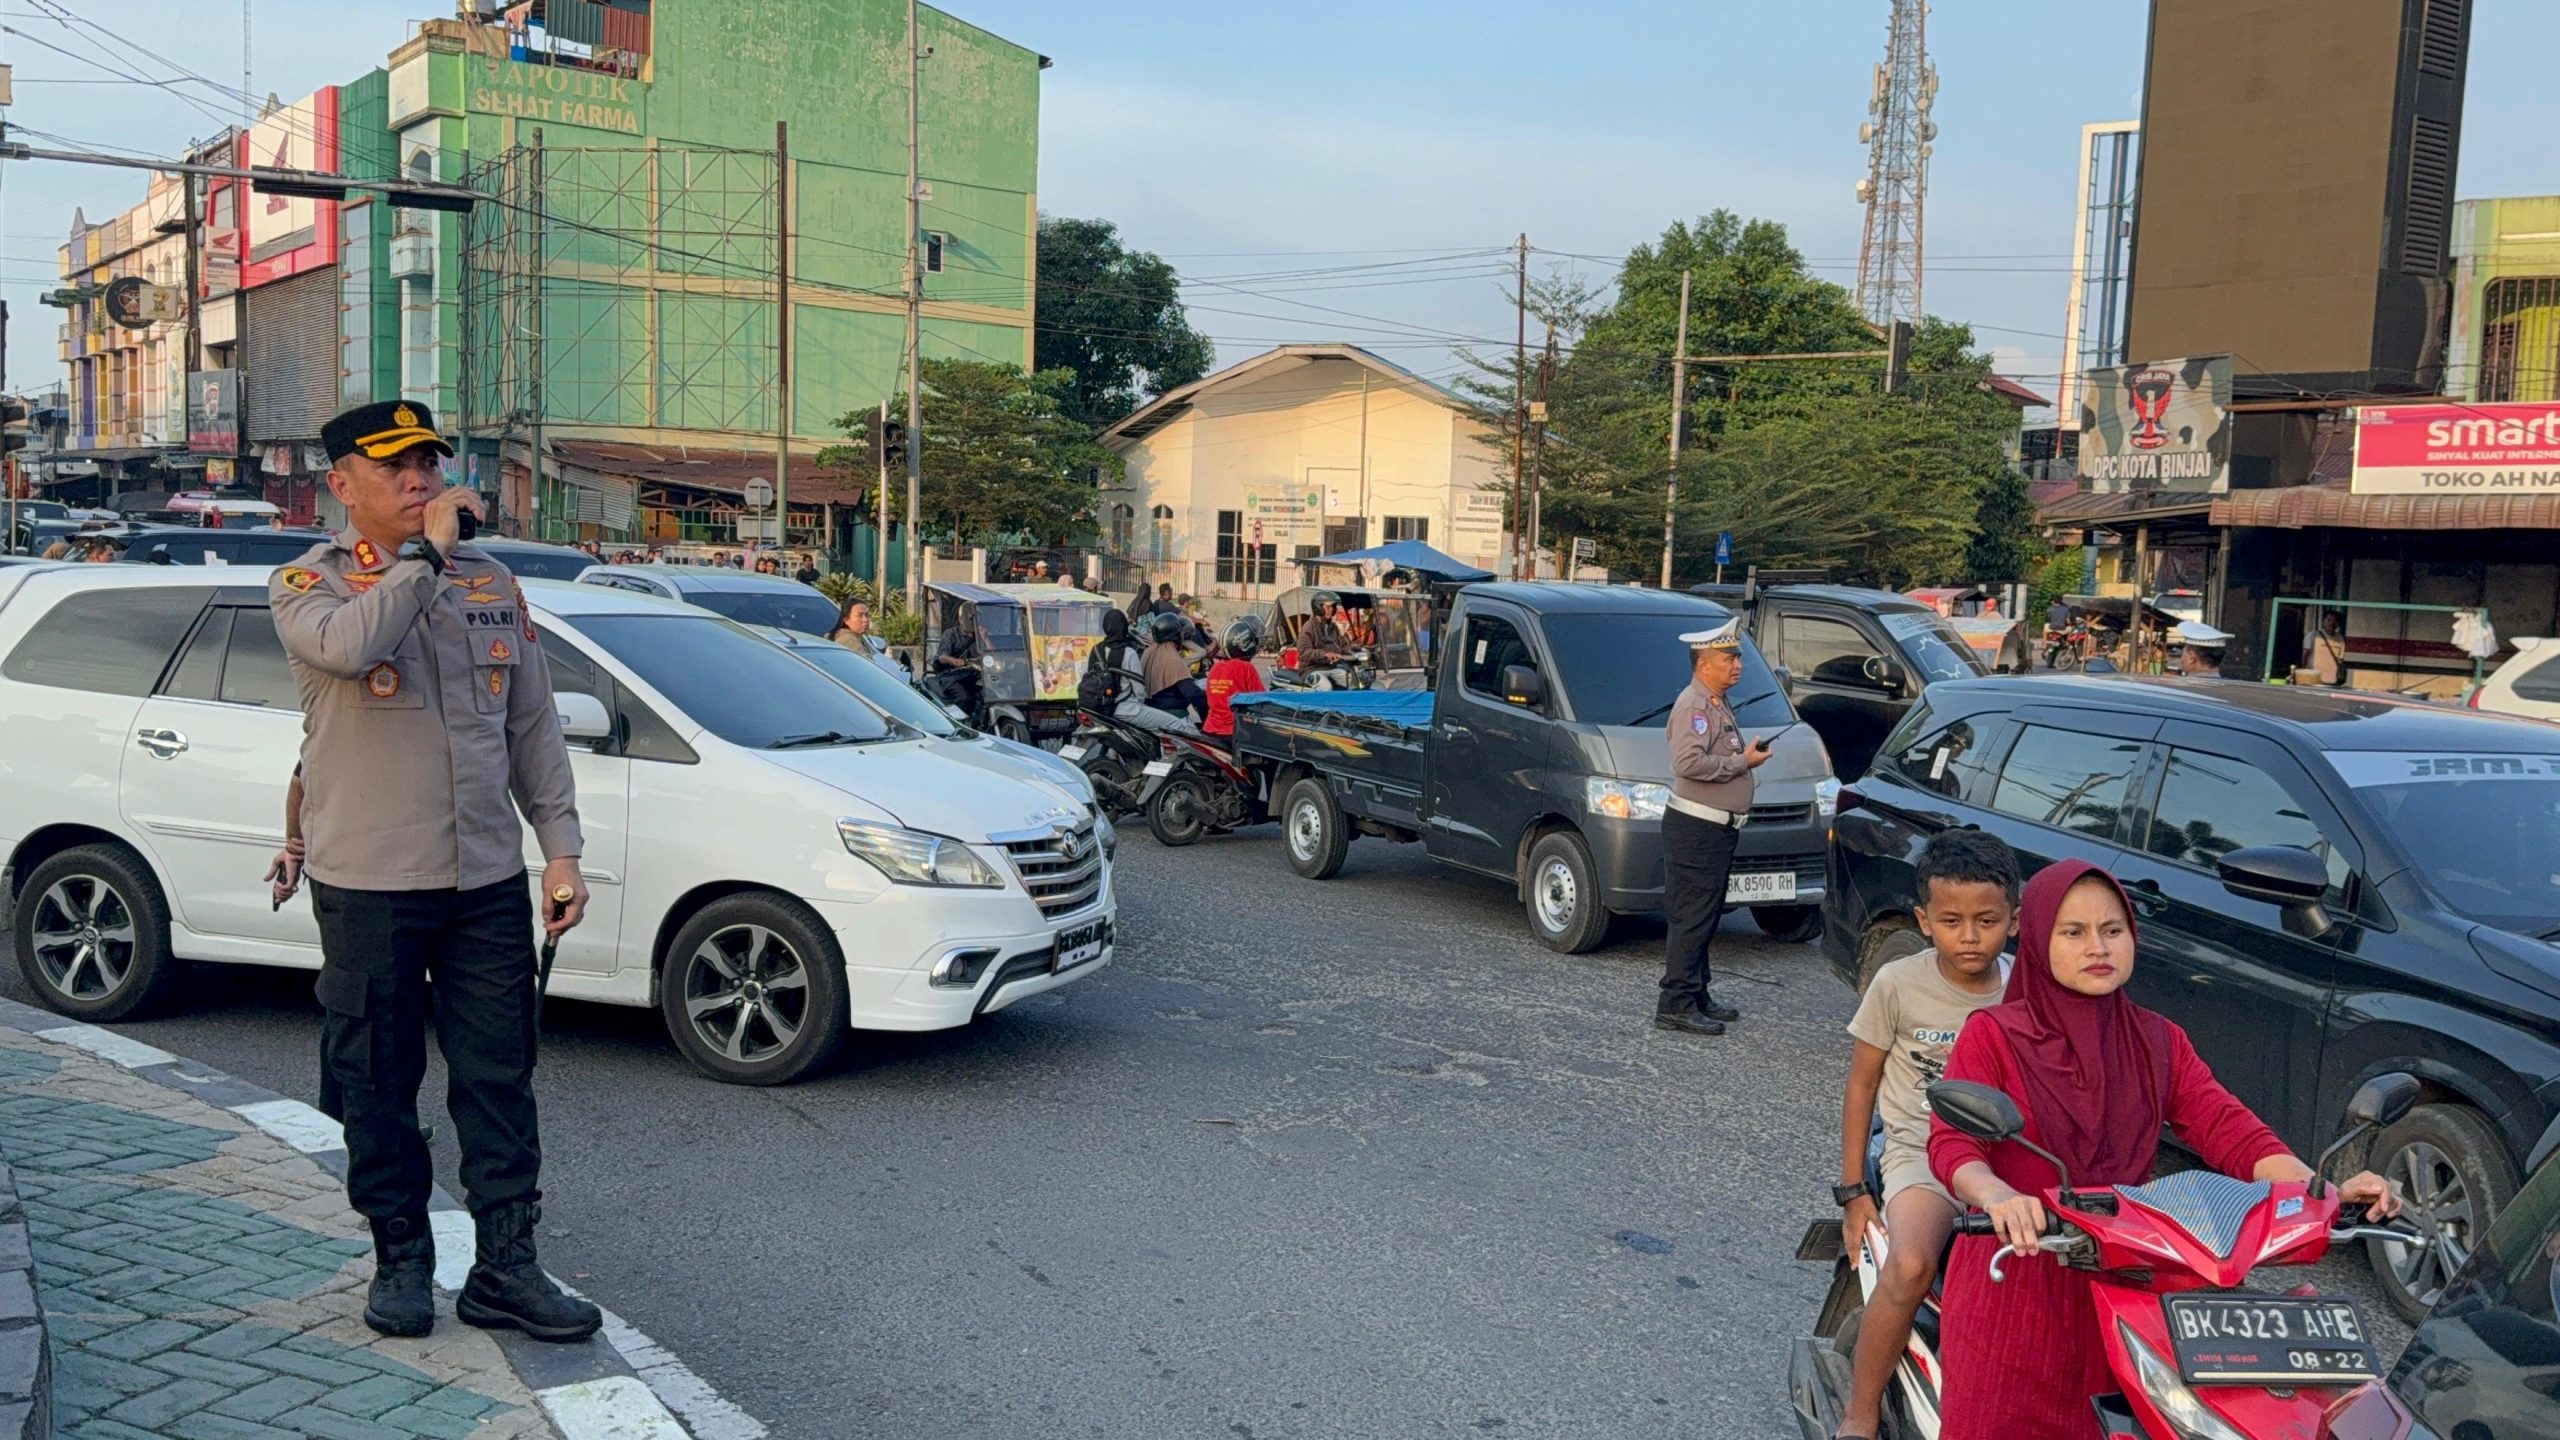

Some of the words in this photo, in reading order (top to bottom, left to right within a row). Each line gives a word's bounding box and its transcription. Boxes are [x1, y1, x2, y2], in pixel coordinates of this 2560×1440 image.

[503, 63, 631, 104] APOTEK
[476, 87, 553, 120] SEHAT
[560, 100, 639, 133] FARMA
[2426, 411, 2560, 446] smart
[2093, 455, 2118, 479] DPC
[2120, 453, 2157, 479] KOTA
[2160, 452, 2212, 478] BINJAI
[2427, 451, 2468, 461] SINYAL
[2471, 451, 2503, 460] KUAT
[2421, 472, 2485, 487] TOKO
[2490, 472, 2525, 487] AH
[466, 611, 513, 626] POLRI
[1728, 876, 1743, 893] BK
[1779, 874, 1793, 890] RH
[2179, 1309, 2219, 1338] BK
[2220, 1309, 2289, 1338] 4323
[2303, 1309, 2359, 1341] AHE
